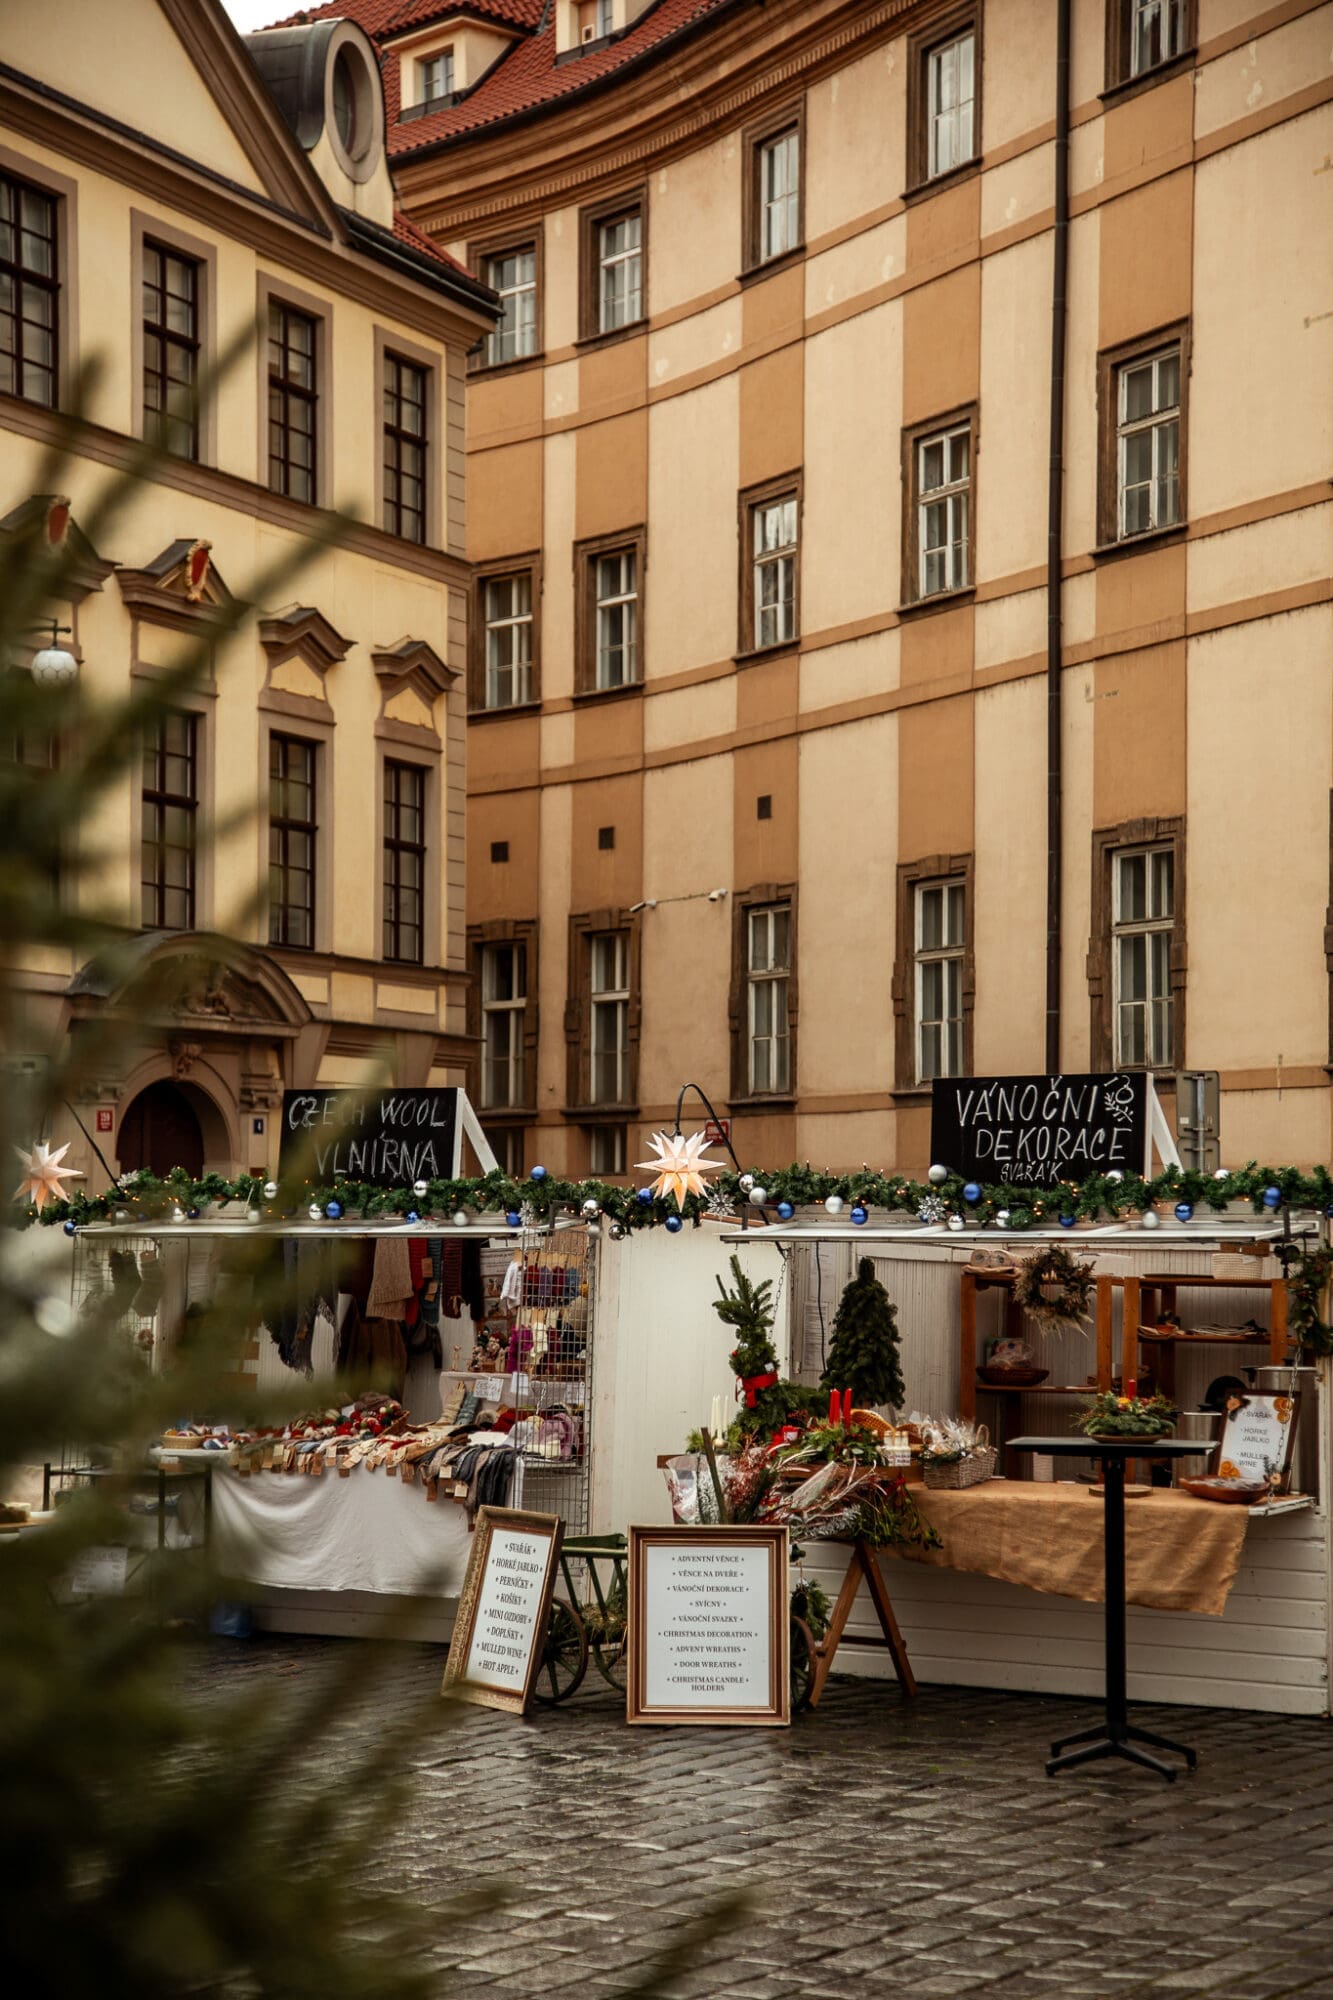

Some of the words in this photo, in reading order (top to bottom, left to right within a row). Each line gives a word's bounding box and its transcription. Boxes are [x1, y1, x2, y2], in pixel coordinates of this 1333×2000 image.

[380, 1096, 447, 1128] WOOL
[975, 1126, 1133, 1162] DEKORACE
[706, 1585, 744, 1593] DEKORACE
[663, 1630, 706, 1638] CHRISTMAS
[480, 1641, 507, 1655] MULLED
[506, 1647, 523, 1659] WINE
[675, 1645, 704, 1653] ADVENT
[705, 1645, 741, 1653] WREATHS
[482, 1659, 497, 1671] HOT
[496, 1663, 516, 1675] APPLE
[671, 1676, 714, 1684] CHRISTMAS
[691, 1684, 725, 1692] HOLDERS
